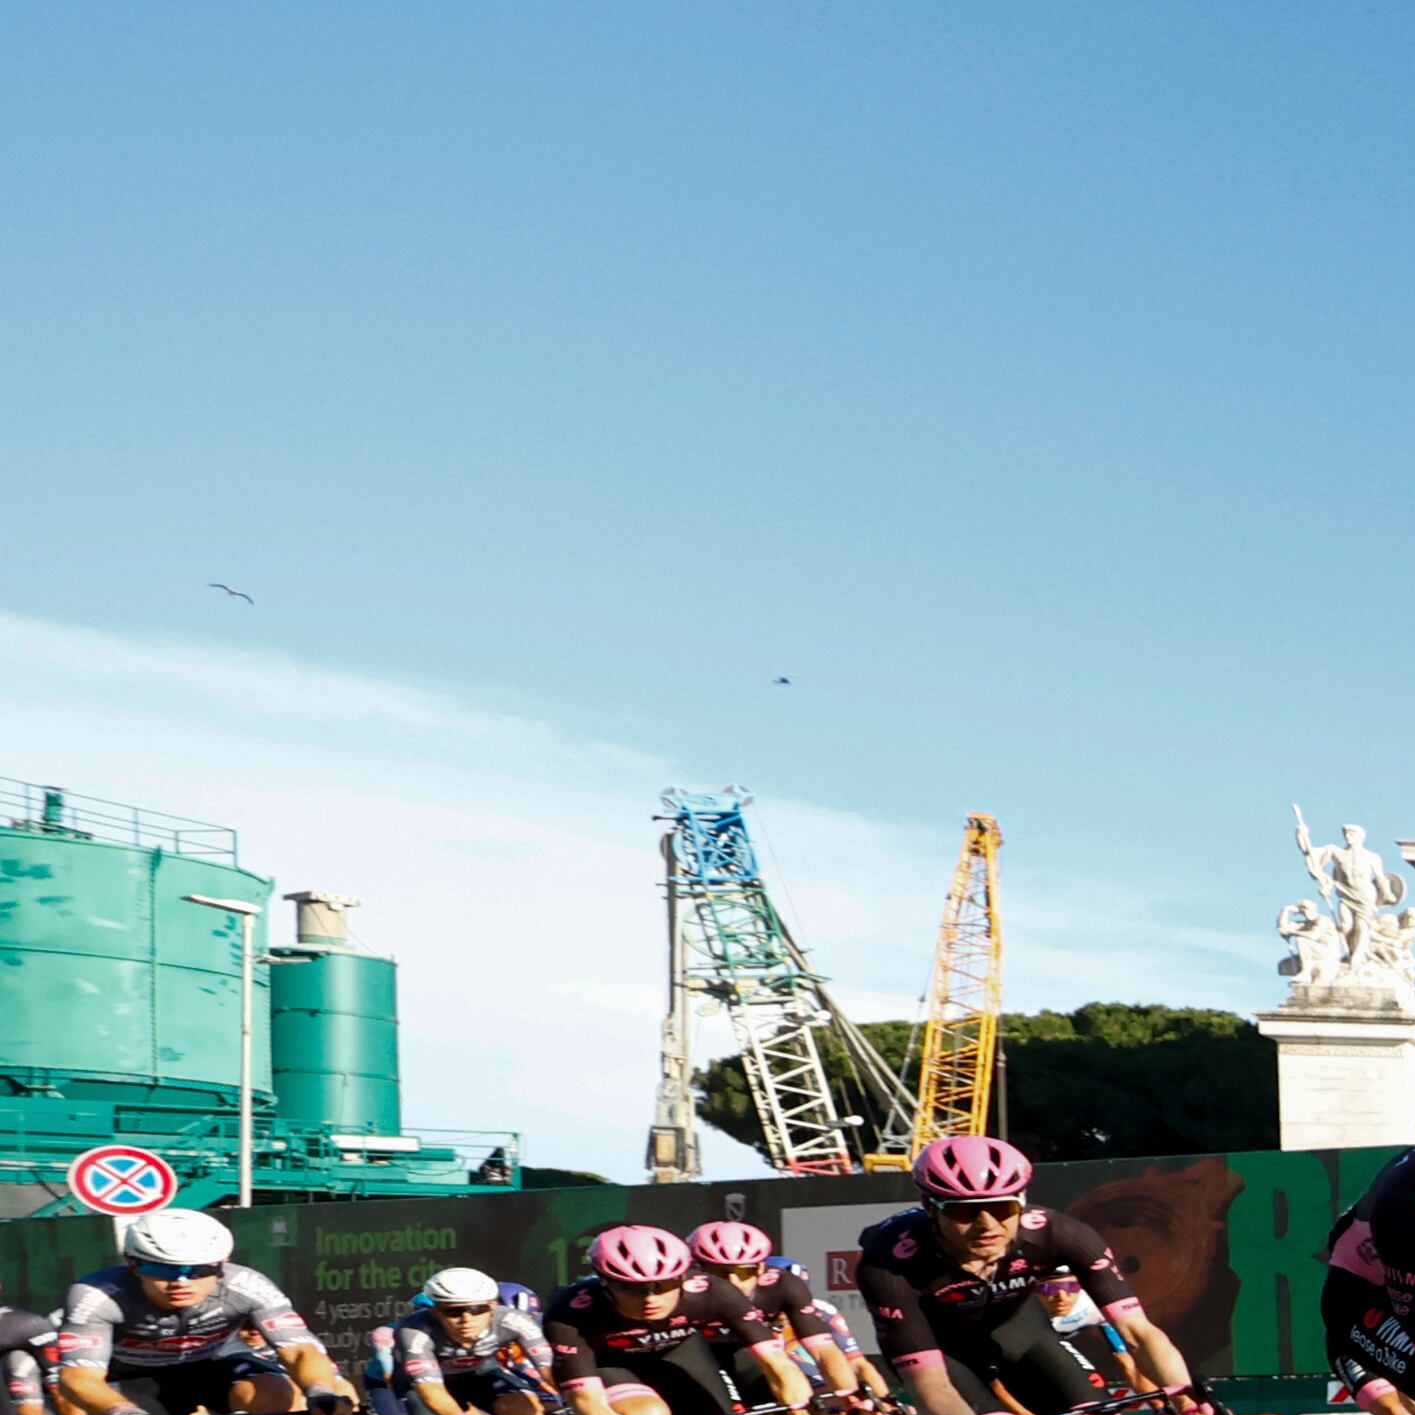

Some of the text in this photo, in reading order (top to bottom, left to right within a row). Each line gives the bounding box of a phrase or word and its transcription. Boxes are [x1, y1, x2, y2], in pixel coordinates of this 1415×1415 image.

[314, 1217, 457, 1256] Innovation
[315, 1259, 354, 1292] for
[359, 1258, 402, 1290] the
